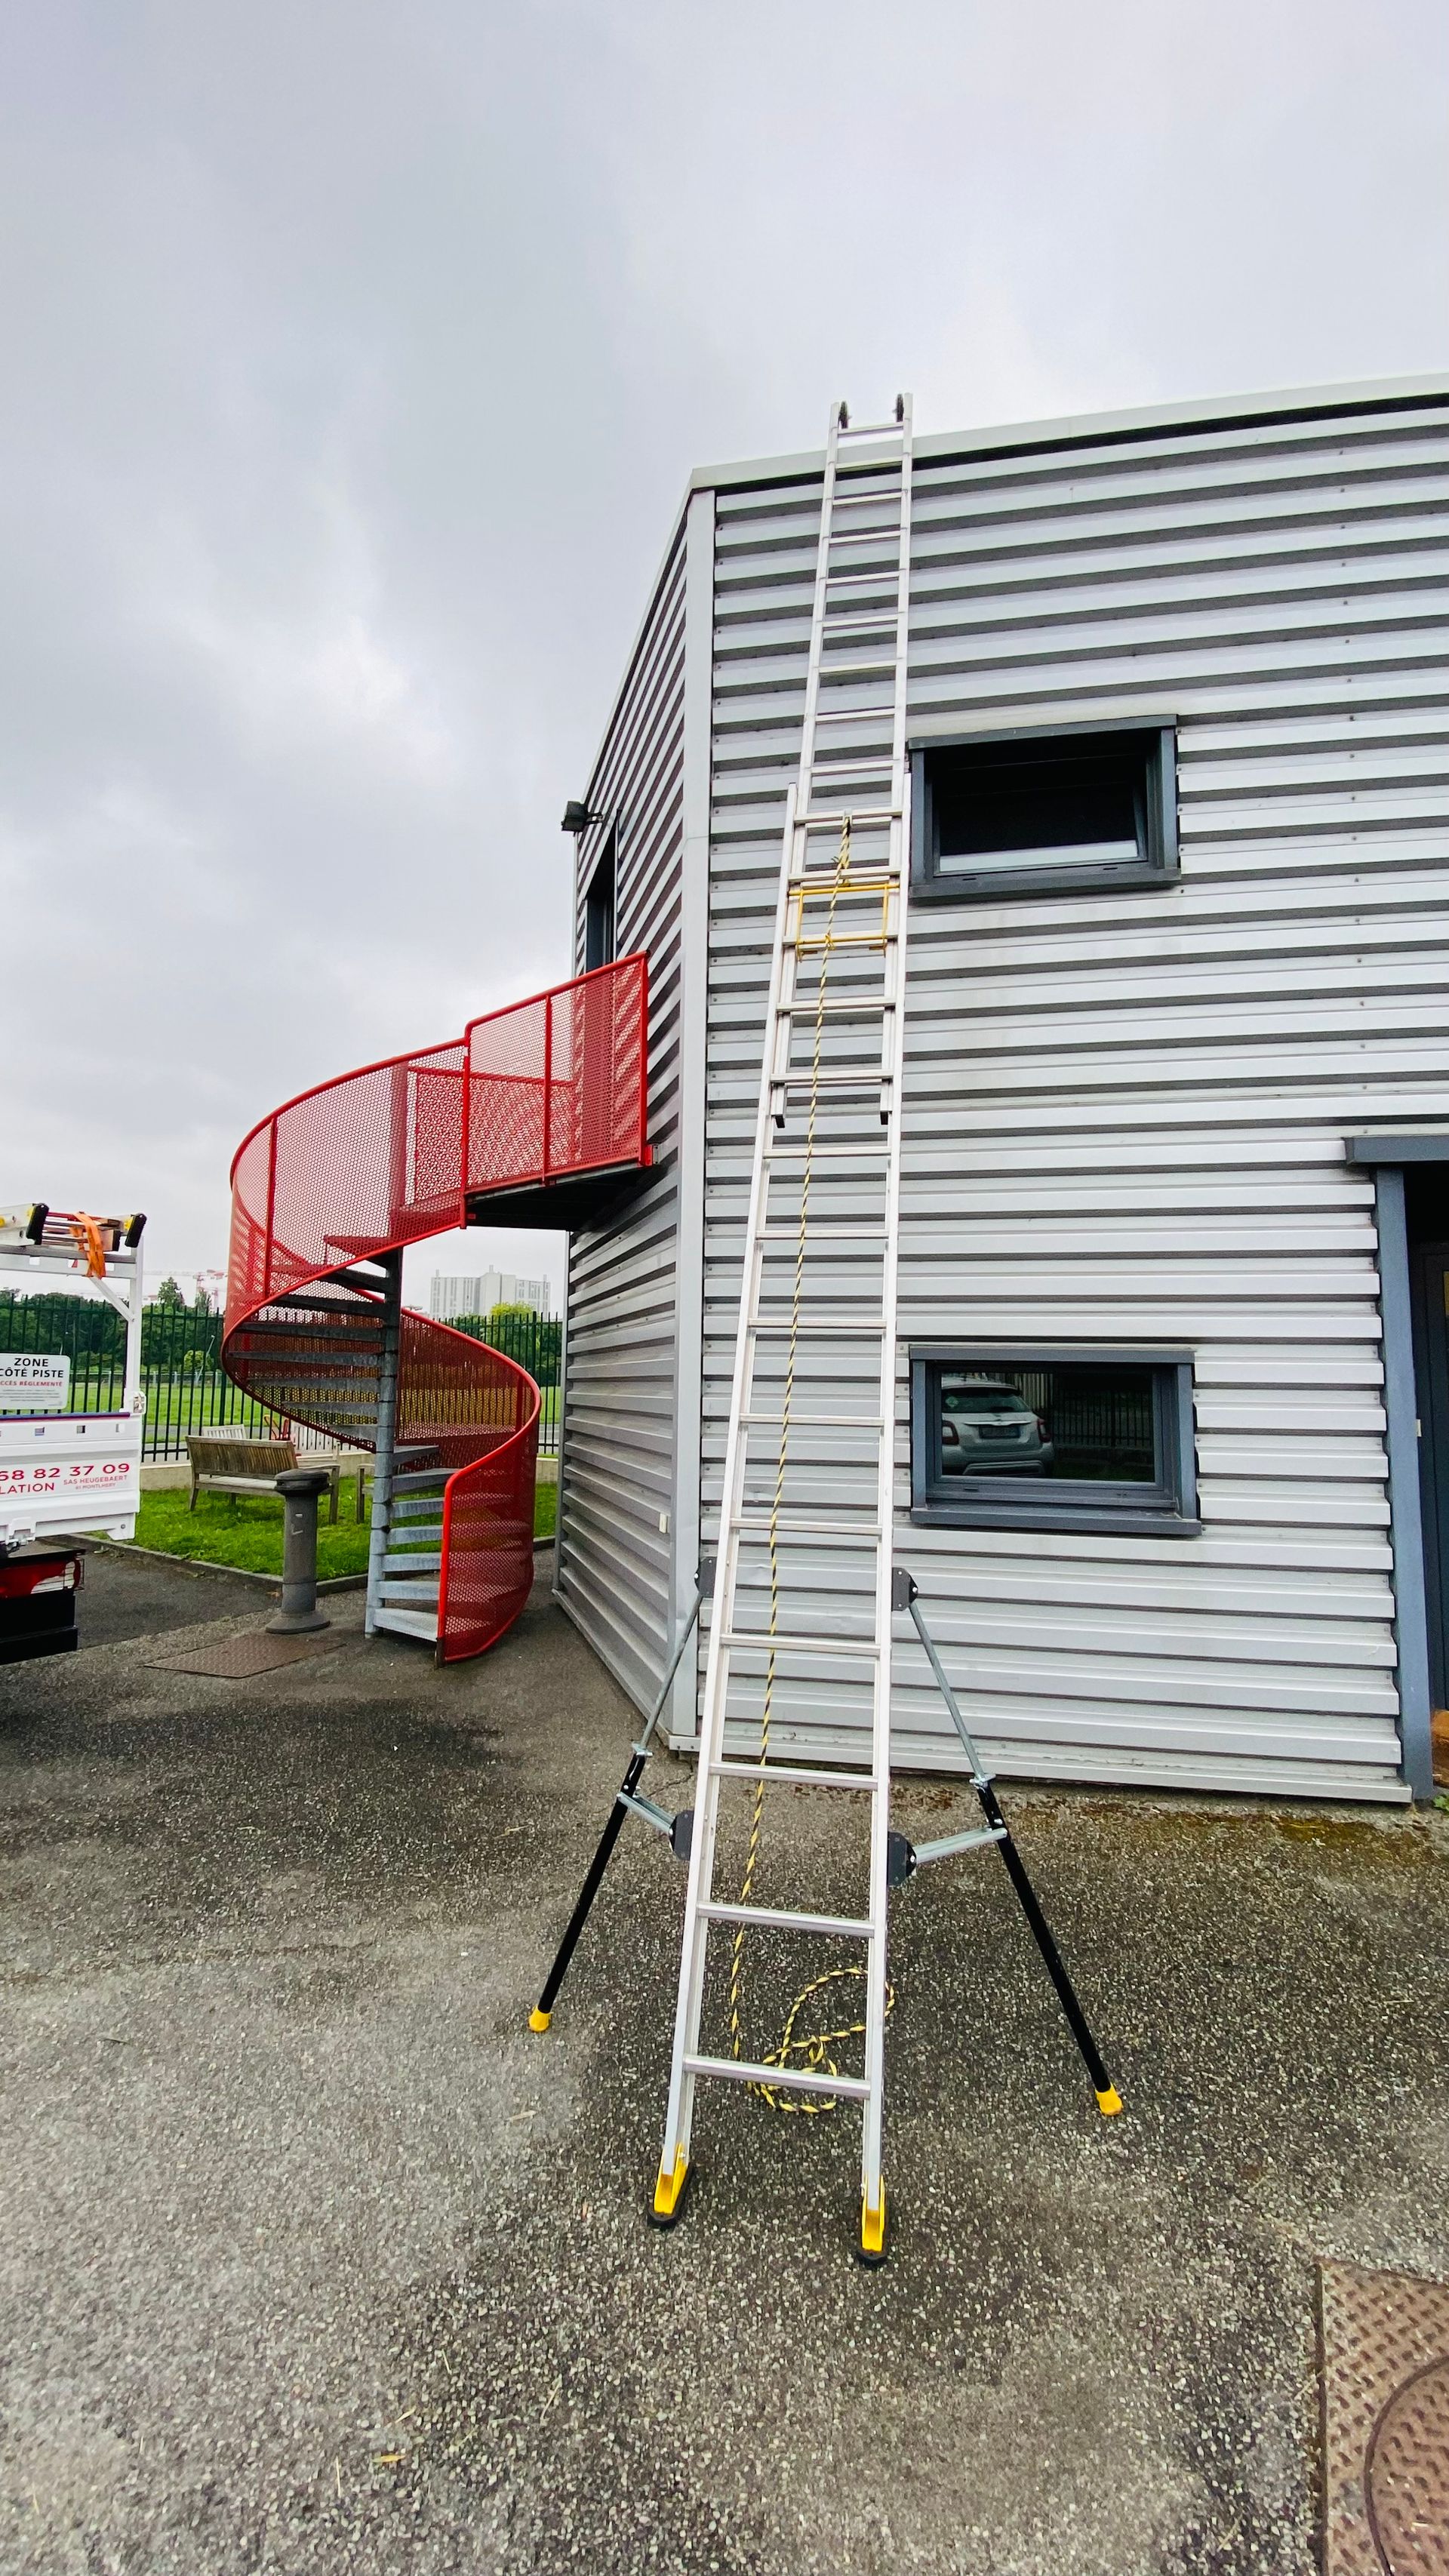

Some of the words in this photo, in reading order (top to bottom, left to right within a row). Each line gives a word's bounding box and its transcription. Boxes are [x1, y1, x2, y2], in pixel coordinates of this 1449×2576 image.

[14, 1358, 48, 1367] ZONE
[0, 1367, 27, 1377] CÔTÉ
[34, 1468, 60, 1479] 82
[69, 1466, 94, 1476] 37
[103, 1463, 129, 1473] 09
[80, 1475, 127, 1483] HEUGEBAERT
